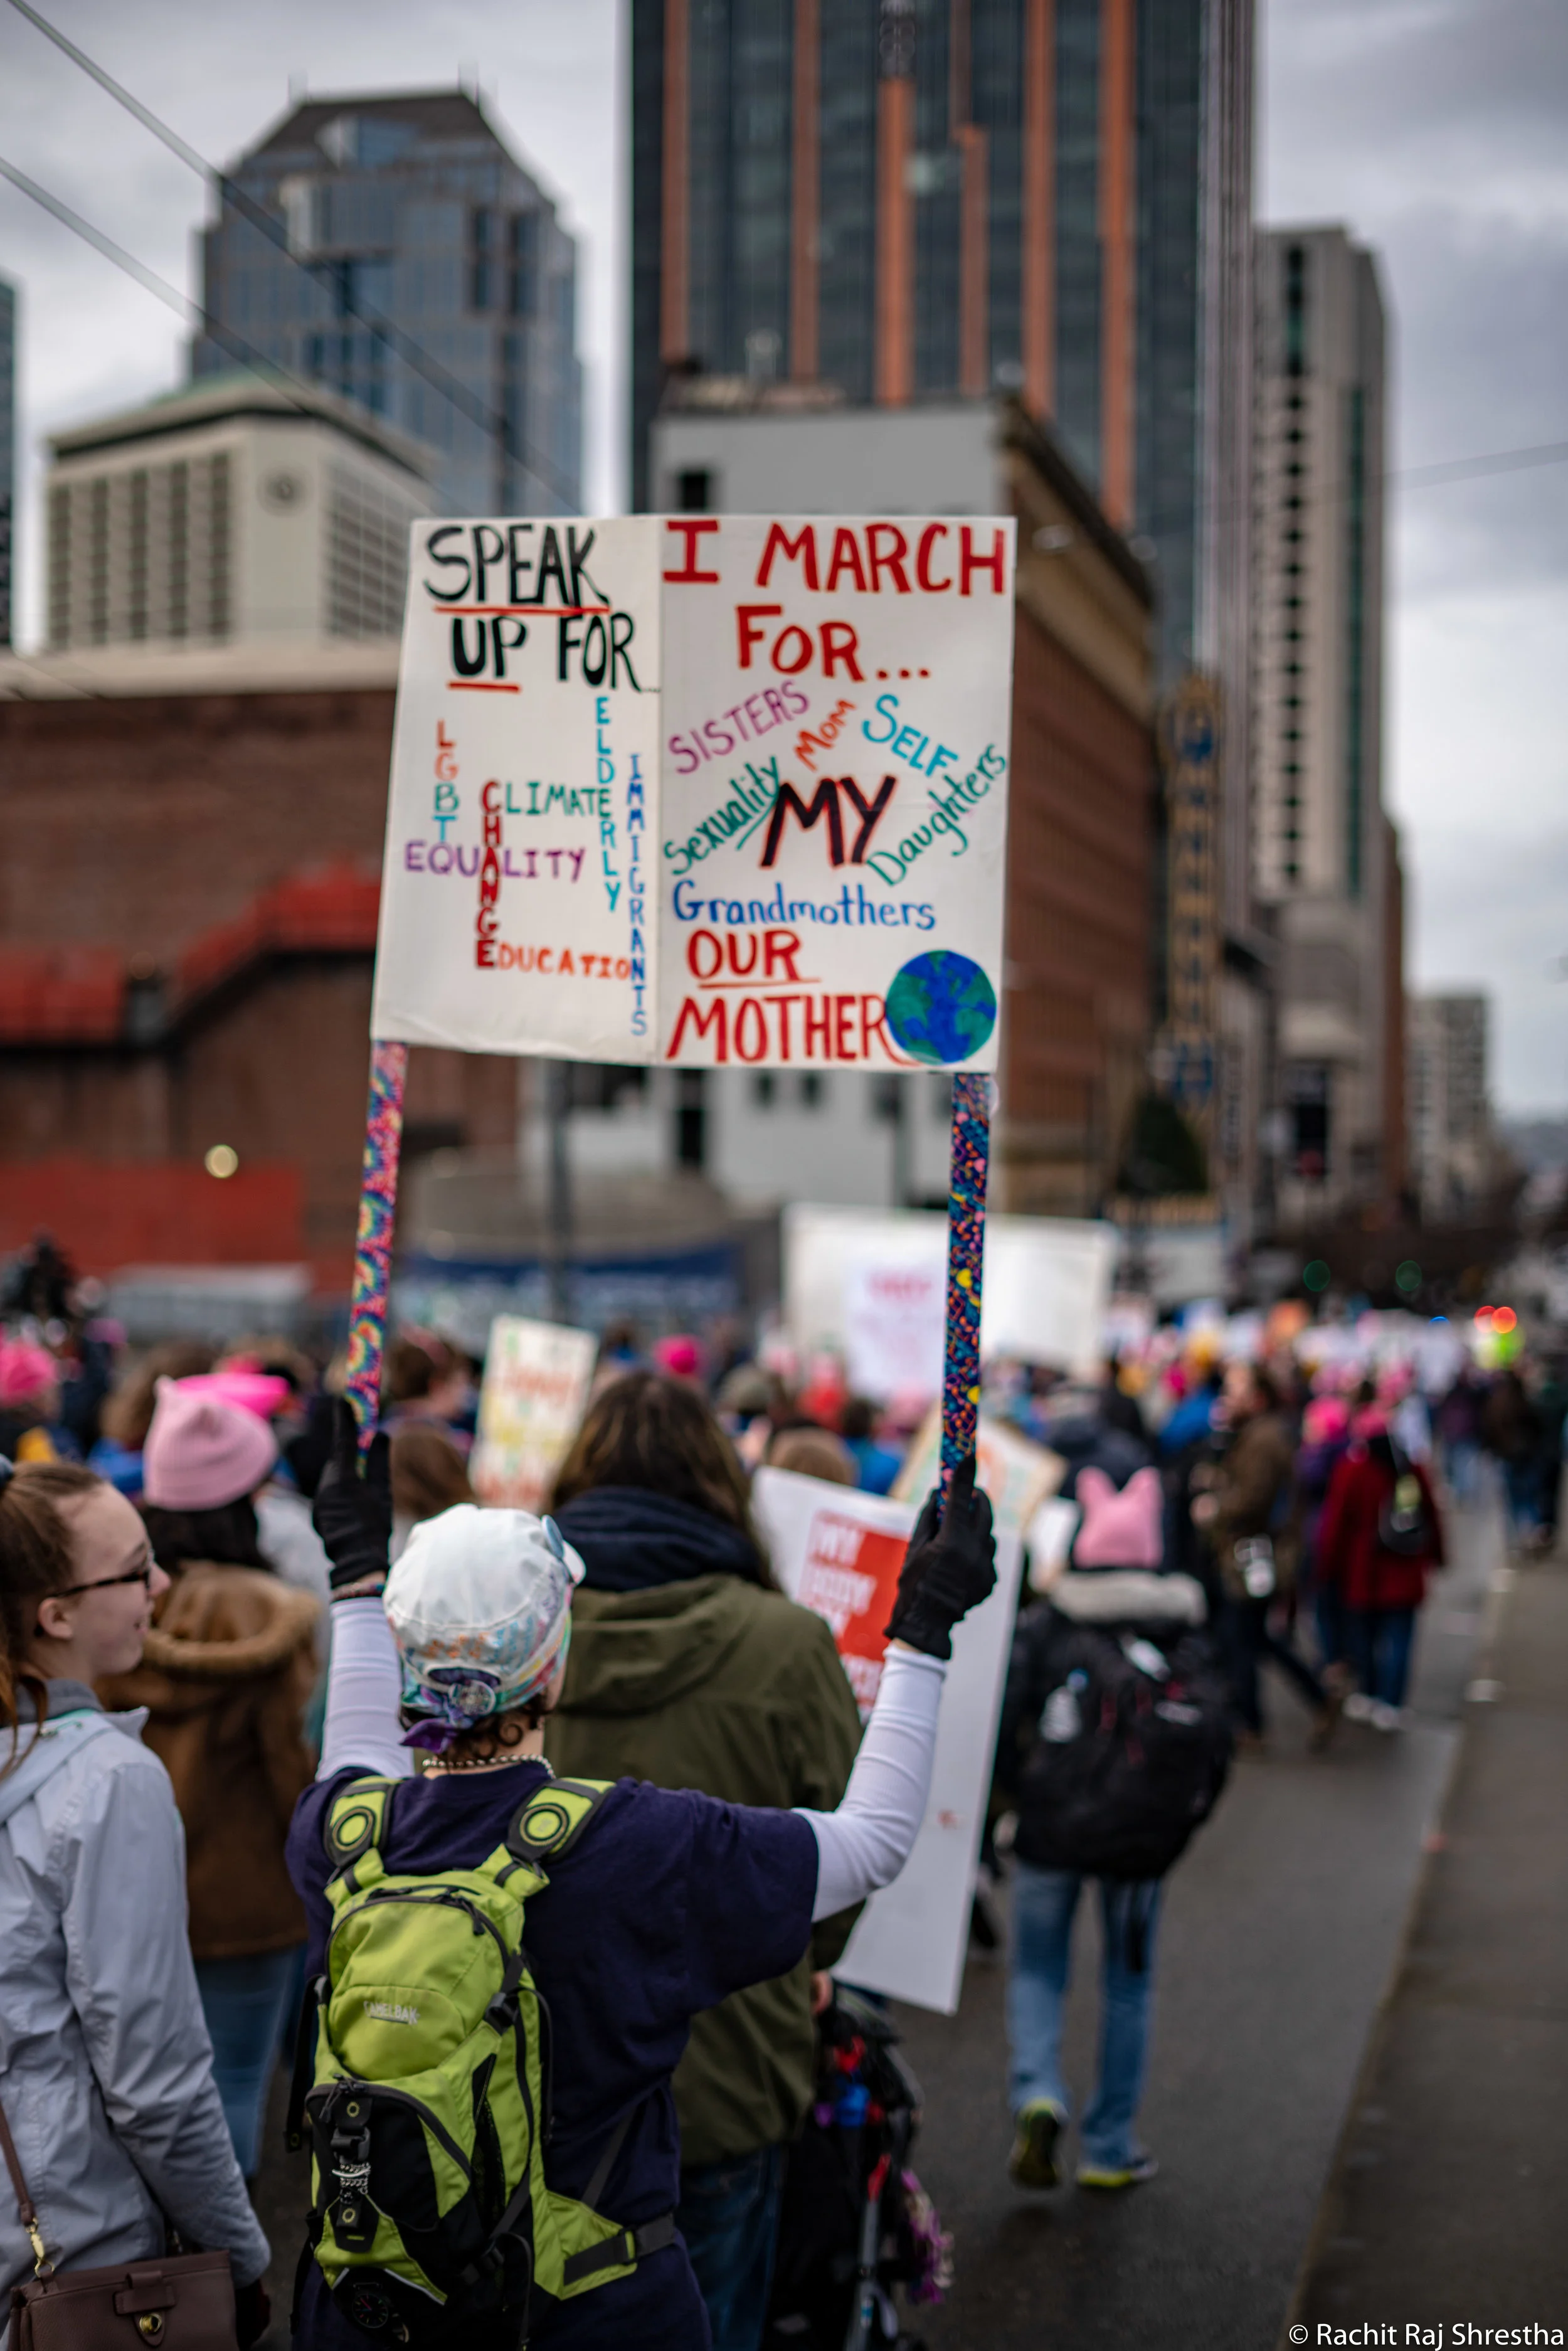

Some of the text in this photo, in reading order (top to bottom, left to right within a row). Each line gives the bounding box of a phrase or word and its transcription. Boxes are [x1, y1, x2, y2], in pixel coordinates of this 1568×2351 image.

[424, 525, 611, 606] SPEAK
[662, 520, 1005, 596] I MARCH
[450, 615, 527, 679] UP
[669, 681, 810, 775] SISTERS
[862, 694, 960, 778] SELF
[595, 696, 621, 913] ELDERLY
[664, 755, 781, 876] Sexuality
[760, 775, 898, 869] MY
[866, 743, 1007, 886] Daughters
[405, 839, 586, 883] EQUALITY
[476, 780, 501, 969] CHANGE
[627, 754, 647, 1037] IMMIGRANTS
[672, 879, 936, 930] Grandmothers
[686, 928, 807, 980] OUR
[665, 994, 922, 1066] MOTHER
